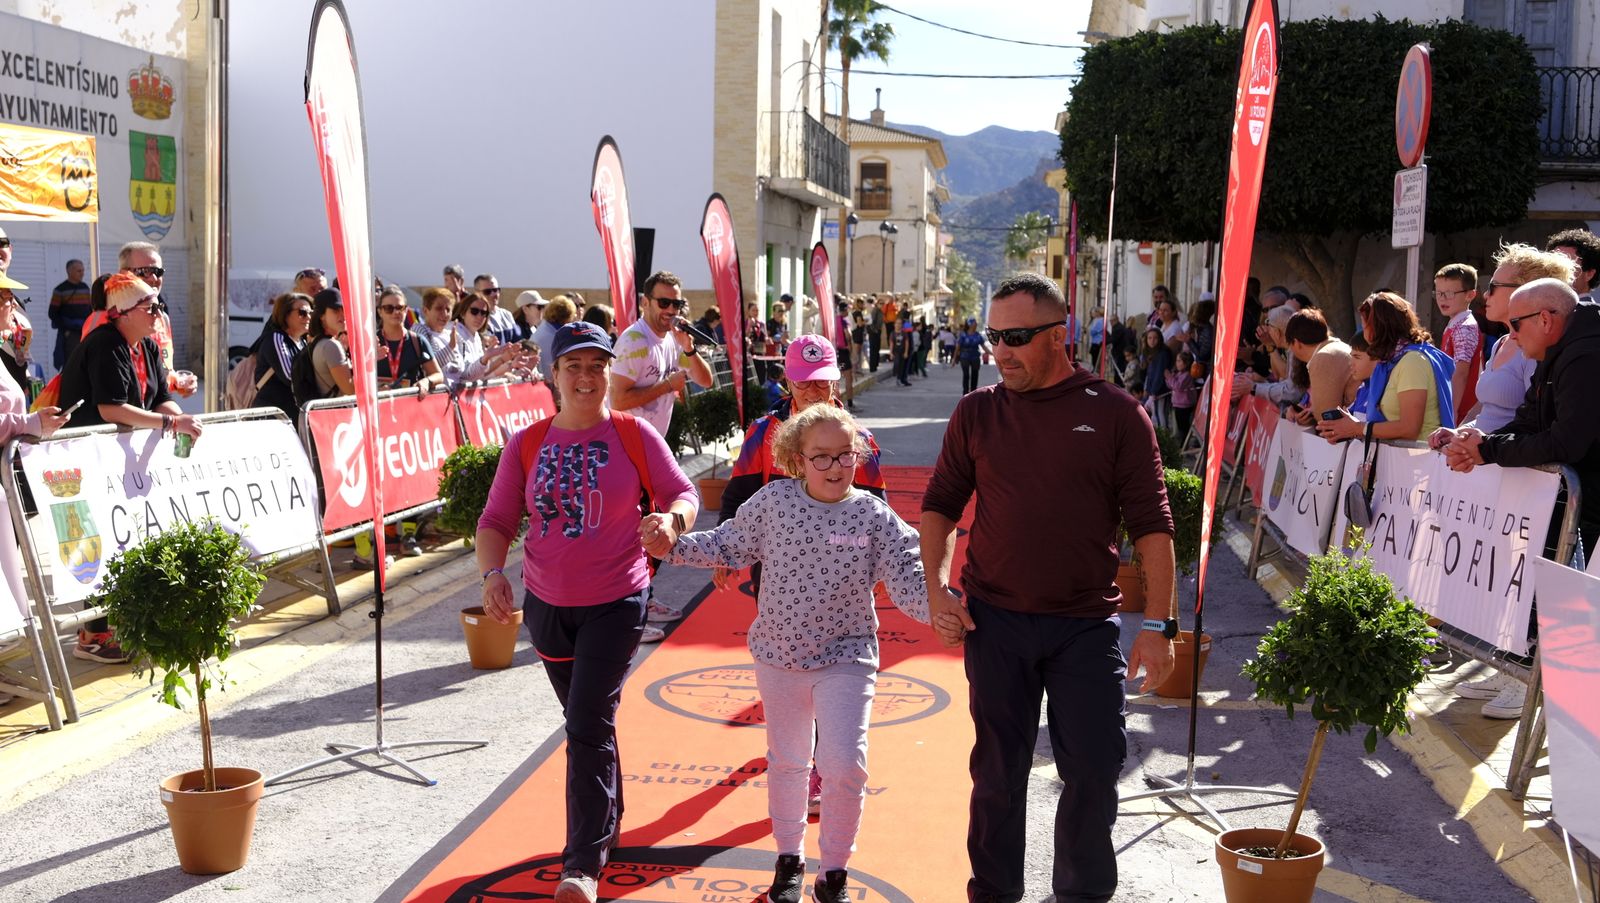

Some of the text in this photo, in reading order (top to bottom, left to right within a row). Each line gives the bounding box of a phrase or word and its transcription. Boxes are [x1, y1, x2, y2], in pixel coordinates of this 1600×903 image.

[1, 49, 119, 99] XCELENTÍSIMO
[269, 451, 293, 470] DE
[111, 475, 306, 546] CANTORIA
[1501, 512, 1531, 541] DE
[1371, 511, 1526, 603] CANTORIA
[604, 862, 695, 875] Canto
